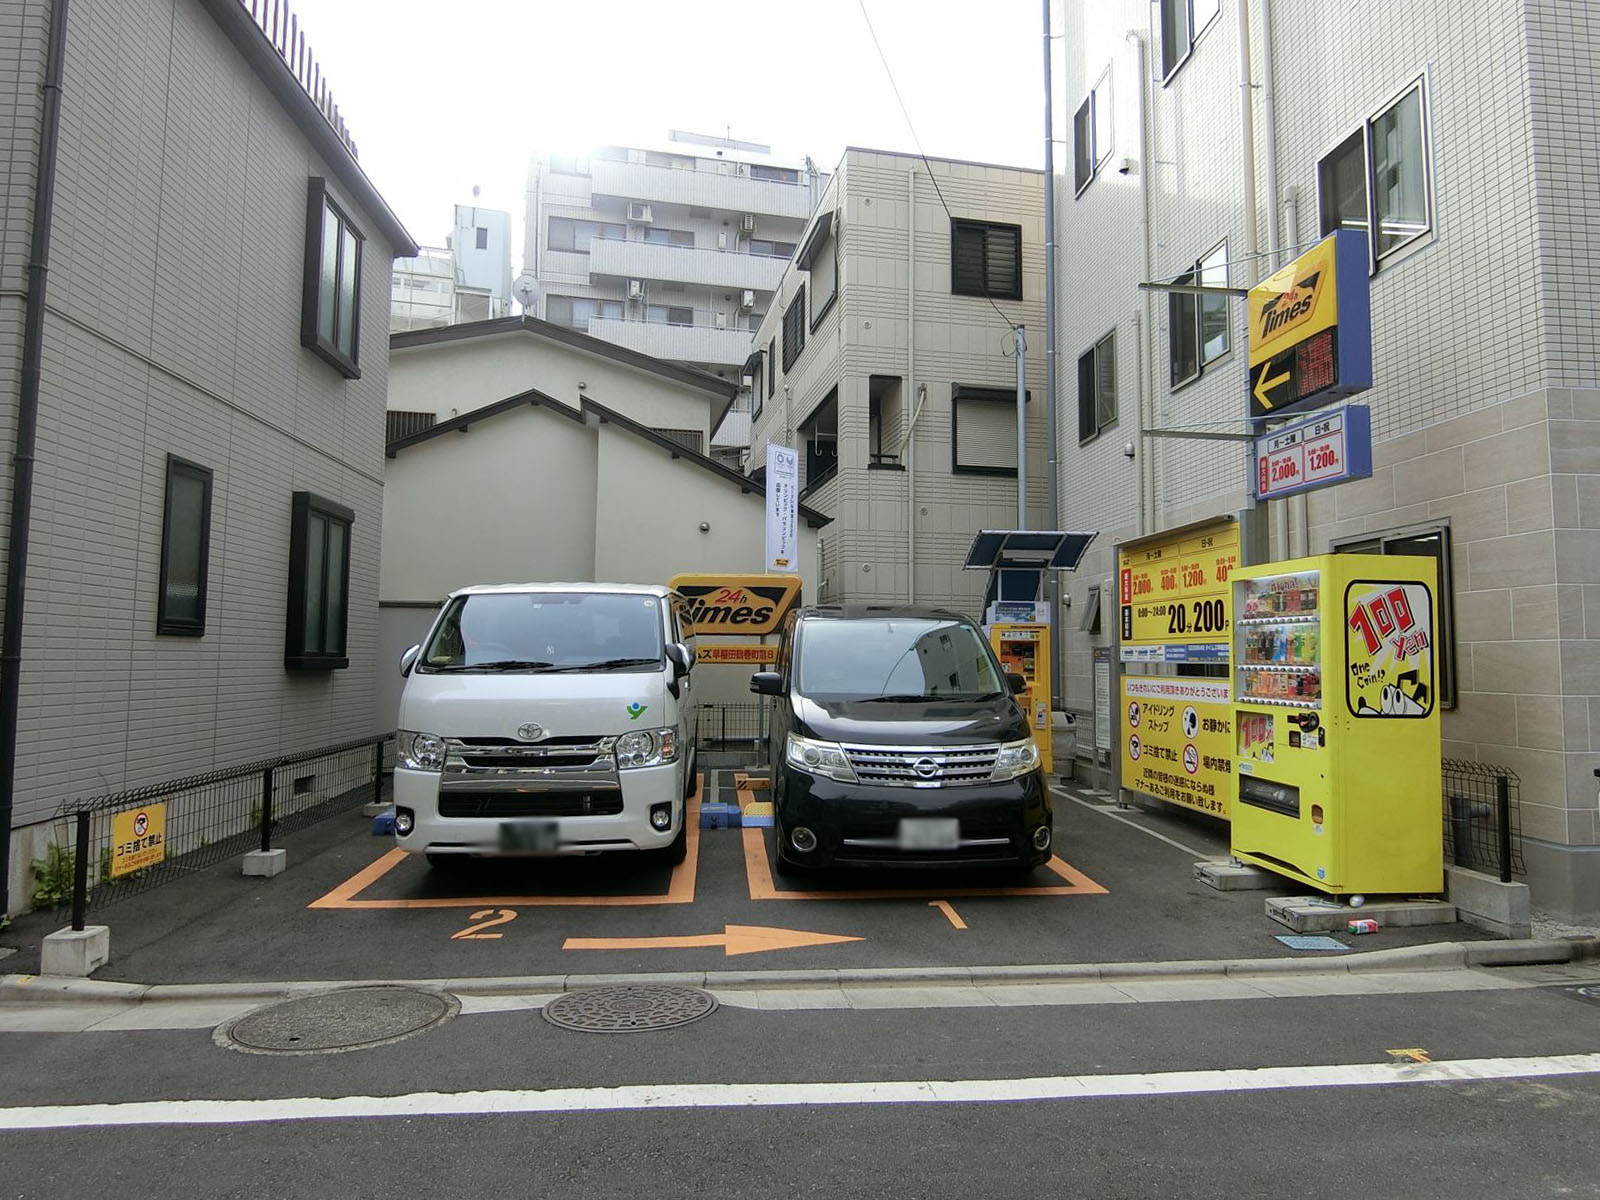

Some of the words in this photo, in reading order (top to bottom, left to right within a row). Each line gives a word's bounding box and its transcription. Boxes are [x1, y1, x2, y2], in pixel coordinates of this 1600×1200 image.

[1262, 294, 1313, 339] Times
[1349, 586, 1415, 656] 100
[1142, 703, 1175, 717] アイドリング
[1148, 719, 1169, 732] ストップ
[1202, 718, 1230, 734] お静かに
[1143, 744, 1178, 762] ゴミ捨て禁止
[117, 833, 162, 857] ゴミ捨て禁止
[451, 909, 518, 939] 2
